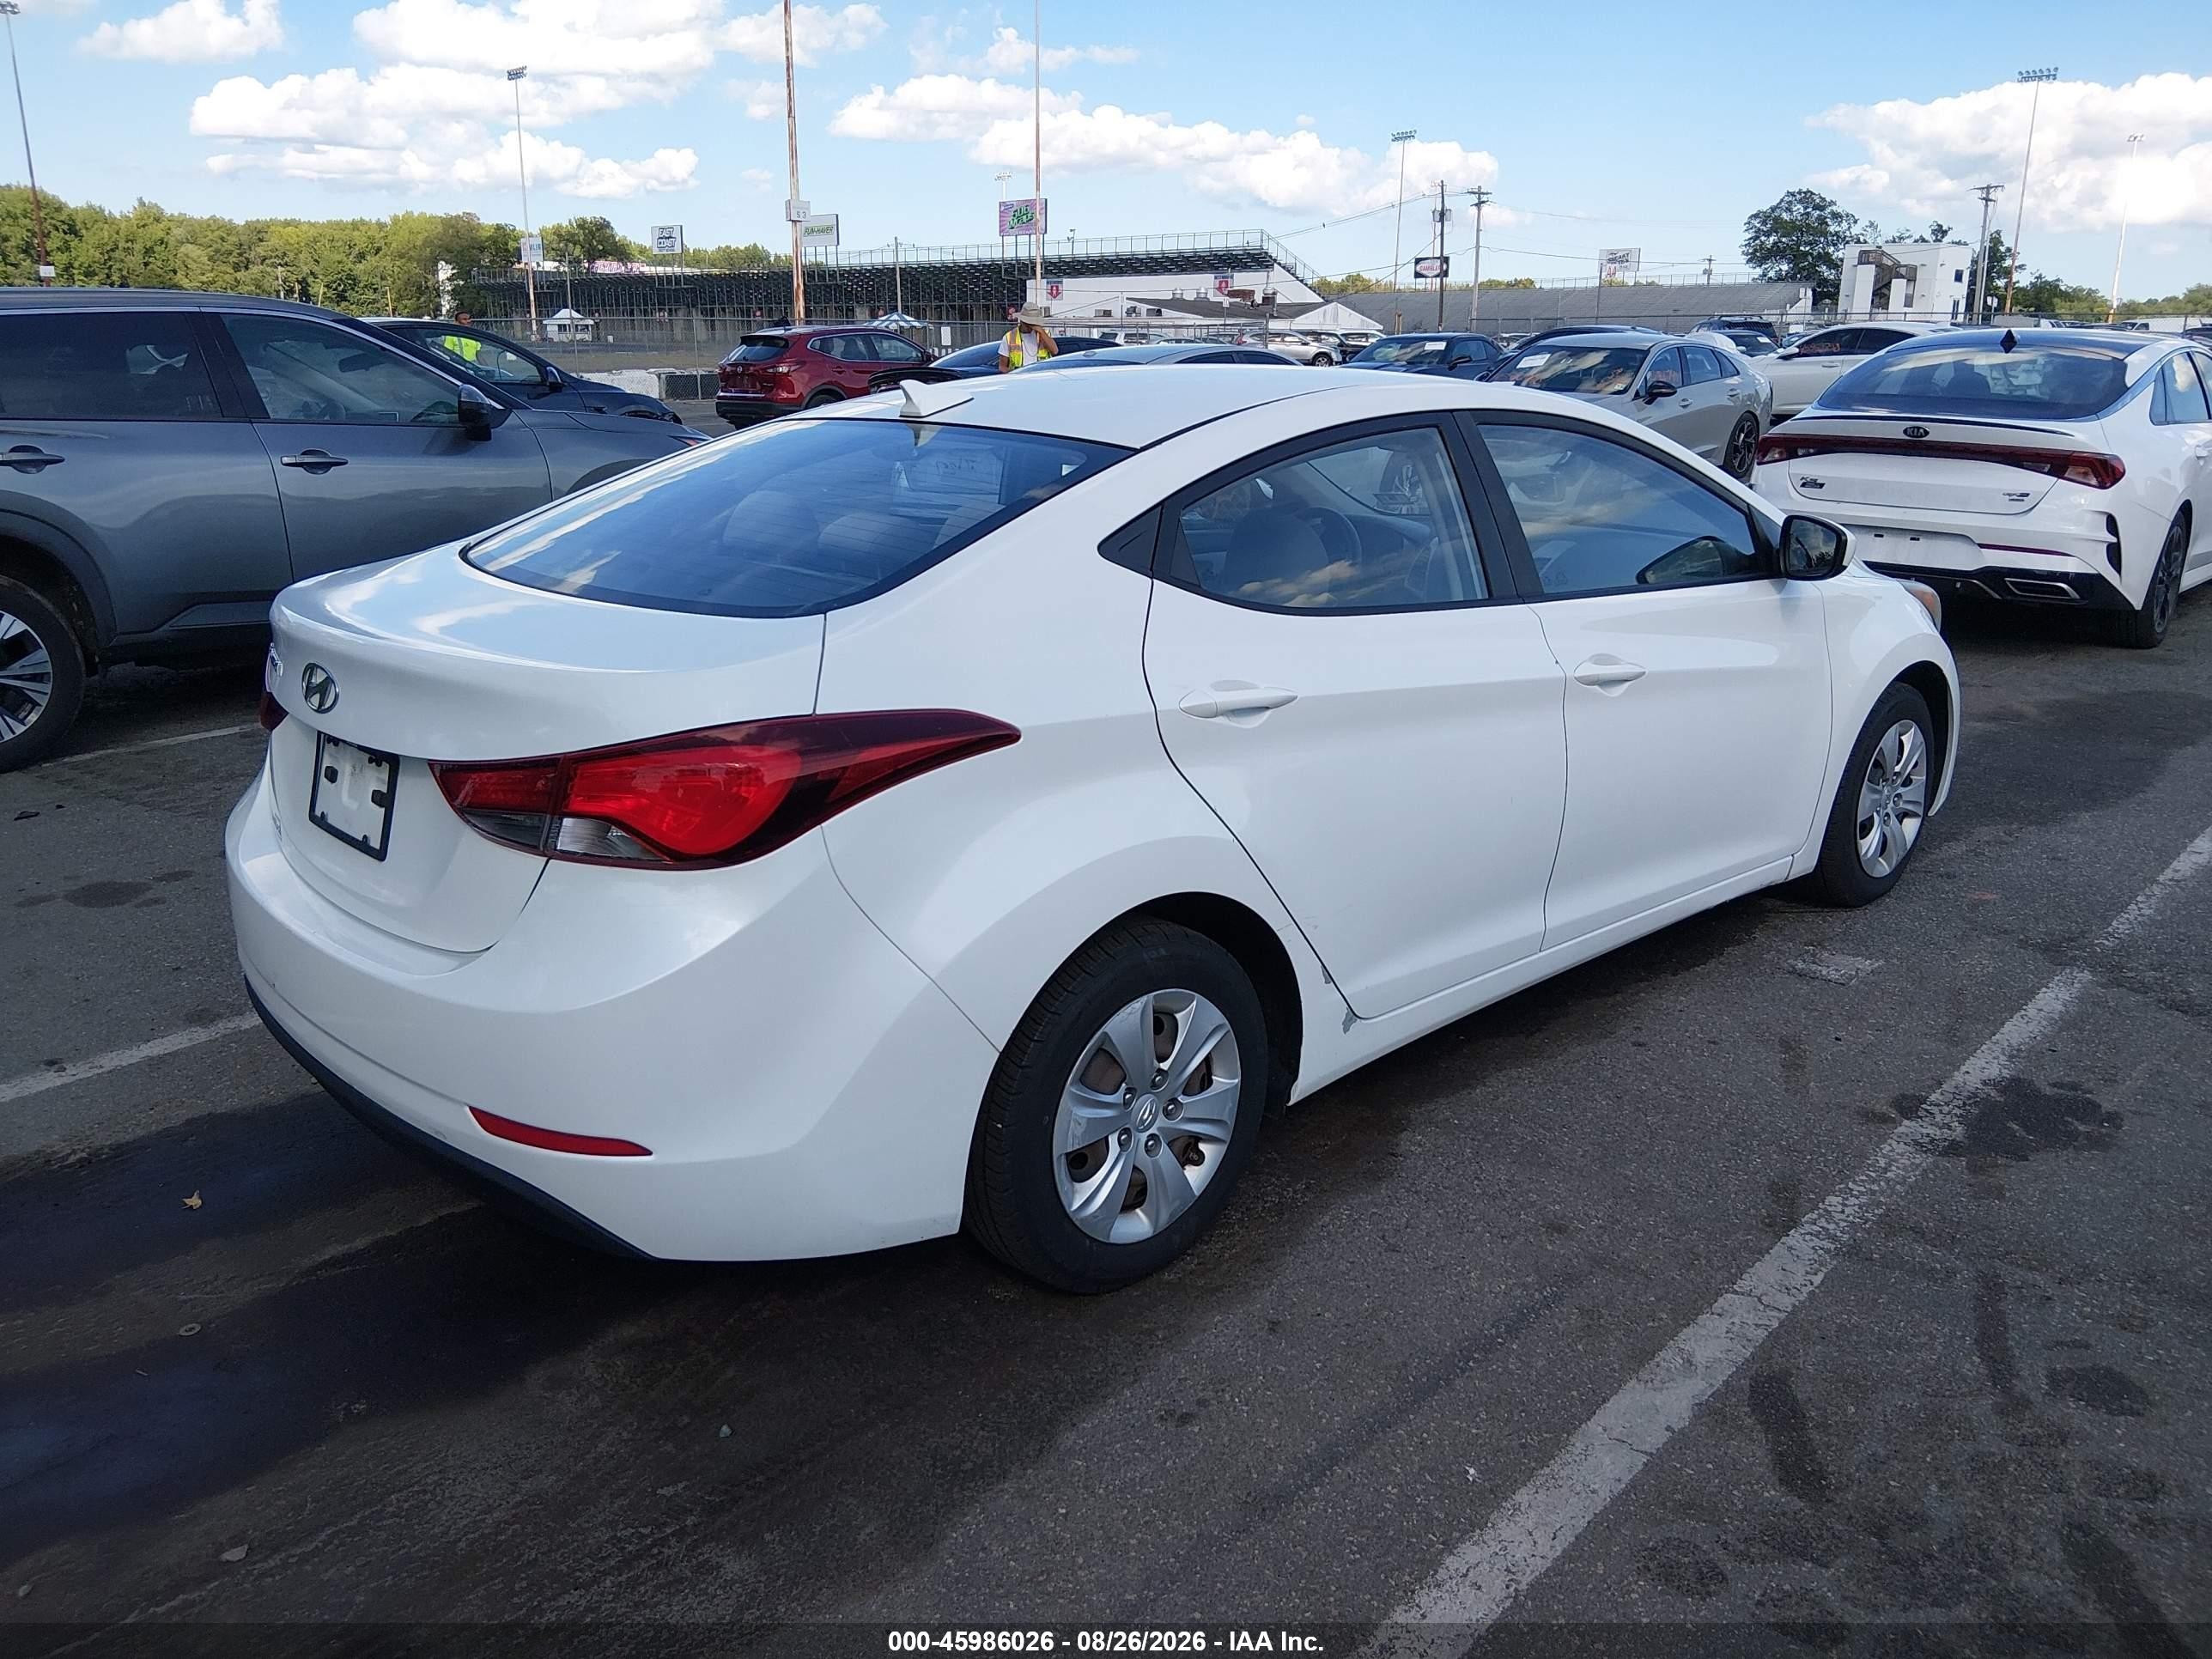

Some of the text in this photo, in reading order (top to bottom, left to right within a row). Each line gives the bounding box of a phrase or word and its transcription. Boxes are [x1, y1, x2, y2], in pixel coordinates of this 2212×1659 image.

[659, 228, 674, 238] EAST
[657, 237, 676, 248] COAST
[1906, 428, 1925, 436] KIA
